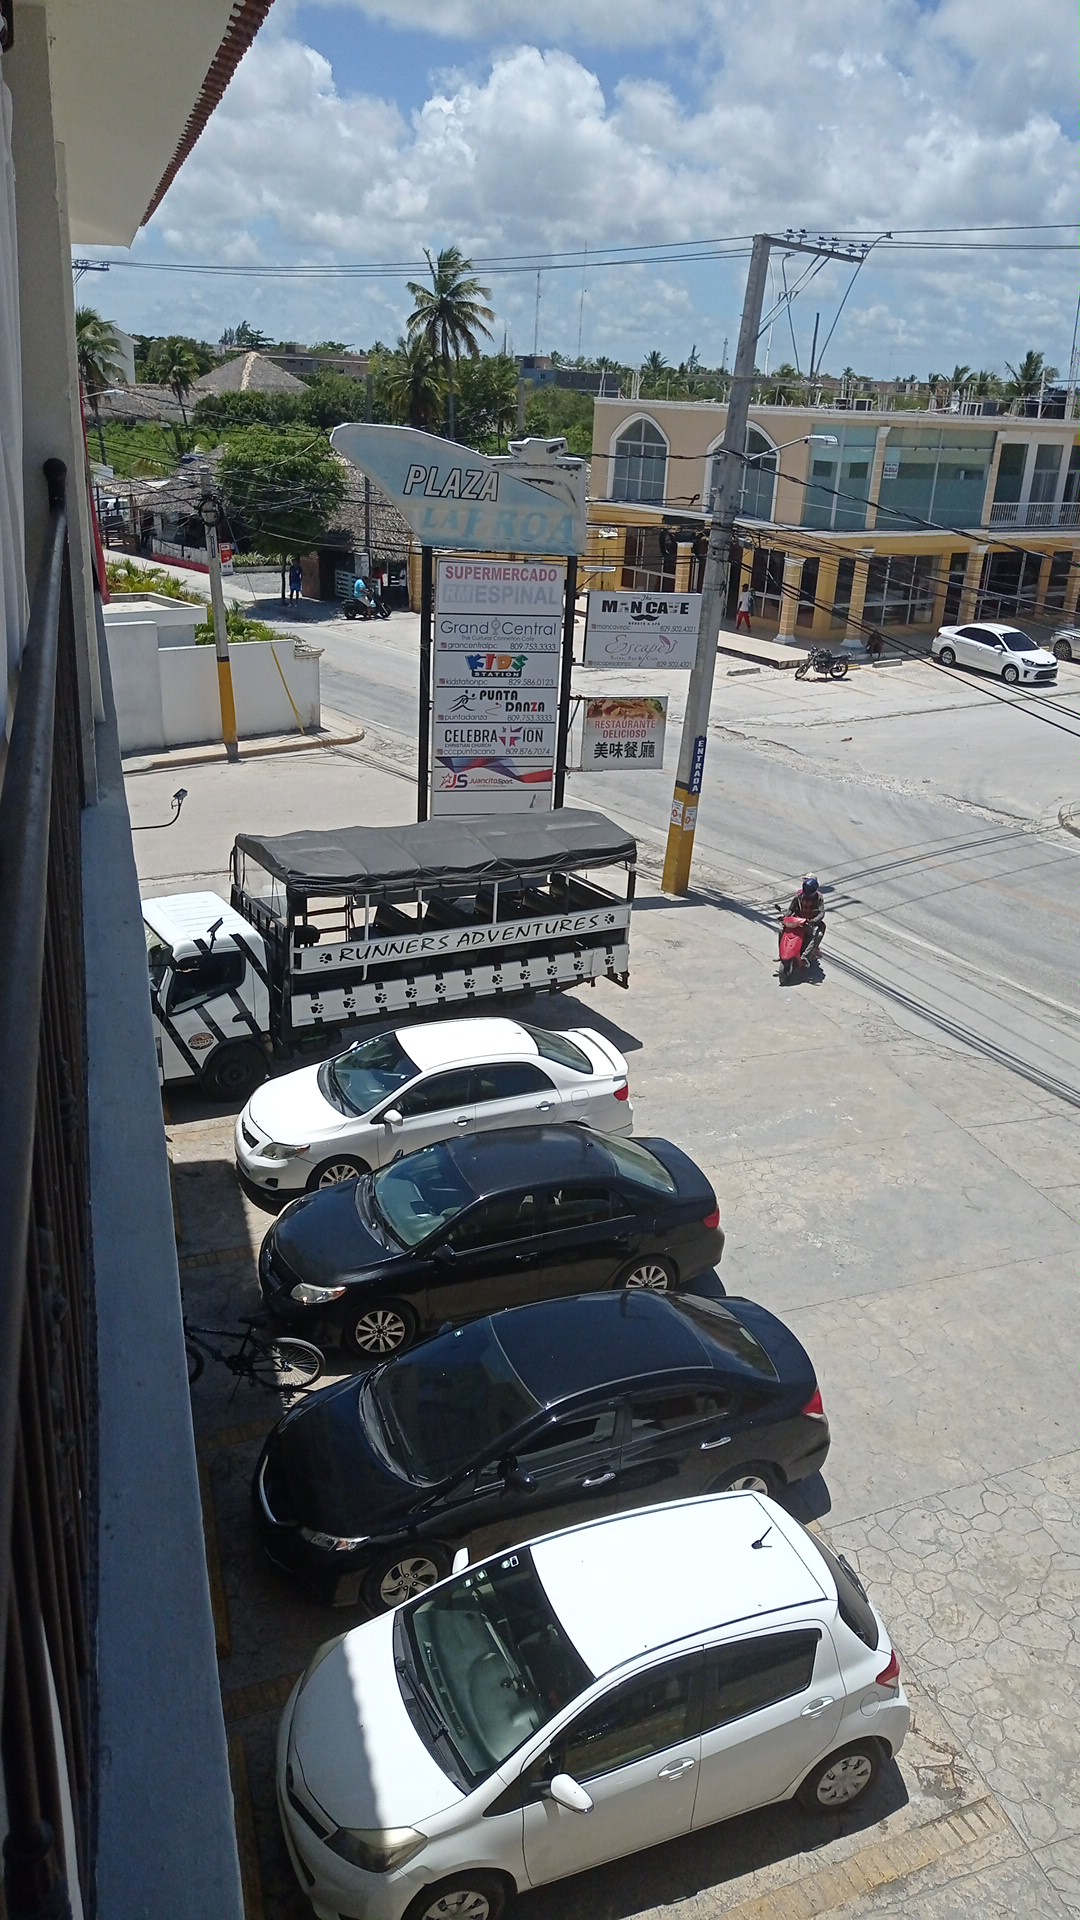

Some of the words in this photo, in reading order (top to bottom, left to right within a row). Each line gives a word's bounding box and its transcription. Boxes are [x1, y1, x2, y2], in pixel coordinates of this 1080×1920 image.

[403, 464, 499, 501] PLAZA
[445, 565, 557, 582] SUPERMERCADO
[475, 585, 559, 605] ESPINAL
[440, 620, 489, 635] Grand
[501, 622, 557, 636] Central
[465, 654, 528, 670] KIDS
[508, 678, 554, 686] 829.586.0123
[480, 690, 518, 700] PUNTA
[505, 702, 545, 712] DANZA
[507, 714, 552, 722] 809.753.3333
[595, 720, 656, 729] RESTAURANTE
[602, 729, 647, 739] DELICIOSO
[444, 748, 496, 756] cccpuntacana
[691, 740, 705, 792] ENTRADA
[339, 935, 449, 961] RUNNERS
[456, 915, 599, 948] ADVENTURES
